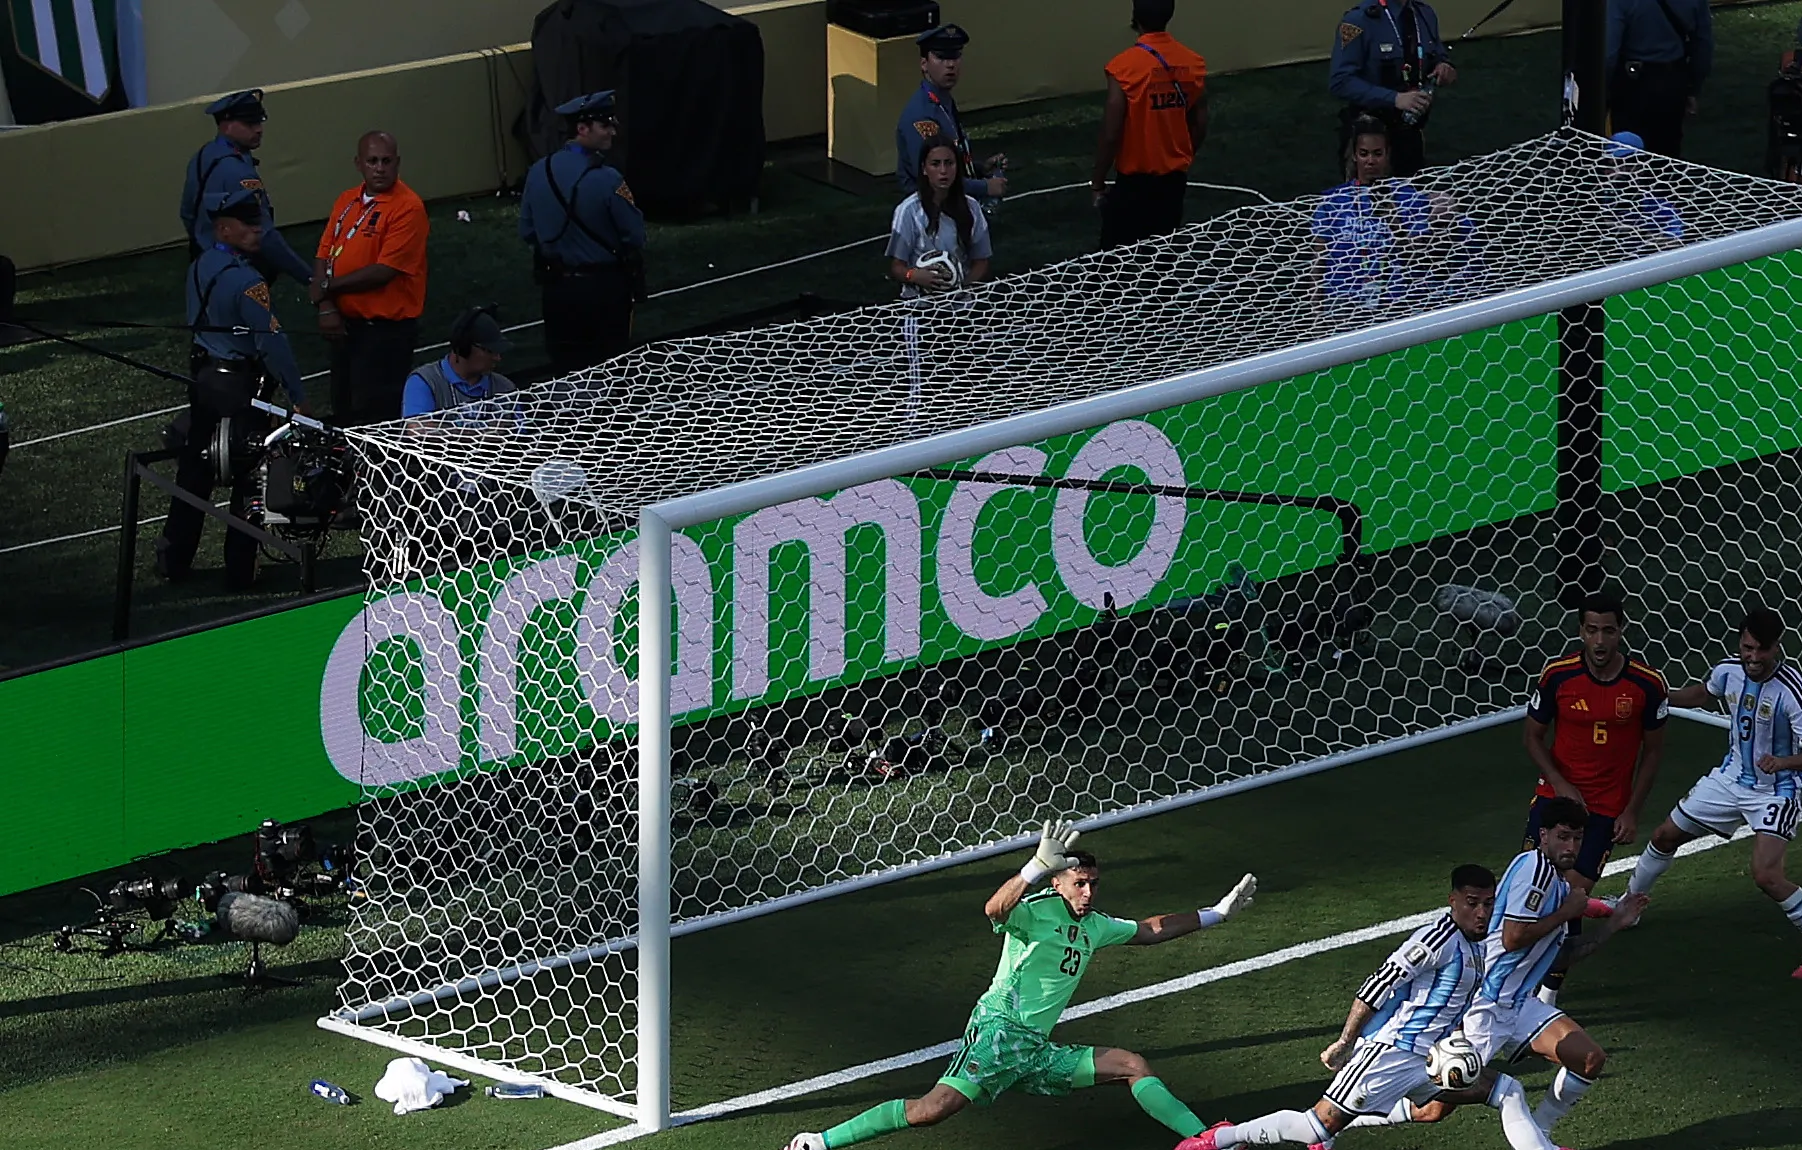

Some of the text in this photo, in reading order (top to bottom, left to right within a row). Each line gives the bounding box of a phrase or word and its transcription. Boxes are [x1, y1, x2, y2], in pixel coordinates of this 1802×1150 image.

[320, 421, 1187, 787] aramco
[1593, 720, 1608, 746] 6
[1739, 715, 1753, 742] 3
[1762, 803, 1780, 826] 3
[1059, 946, 1081, 977] 23
